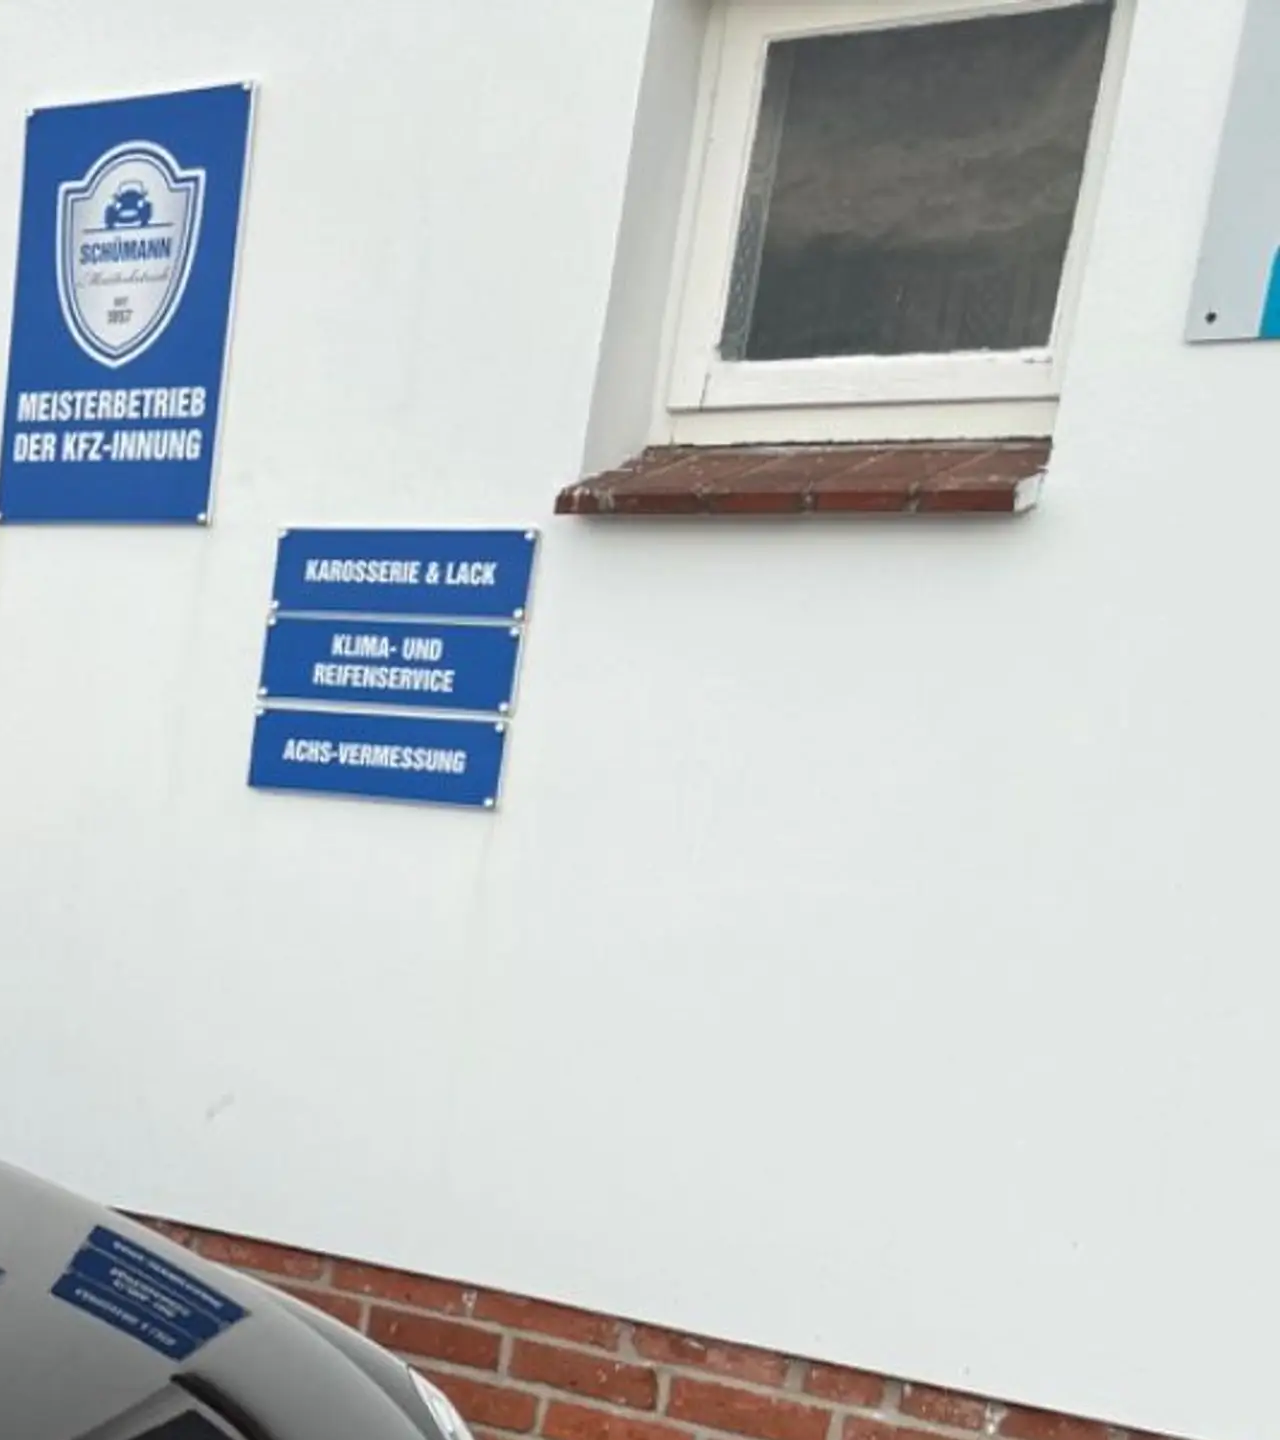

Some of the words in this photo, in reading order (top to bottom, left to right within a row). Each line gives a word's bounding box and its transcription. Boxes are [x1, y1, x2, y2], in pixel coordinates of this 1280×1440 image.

[80, 237, 171, 264] SCHÜMANN
[17, 386, 206, 422] MEISTERBETRIEB
[13, 431, 57, 463] DER
[61, 427, 203, 462] KFZ-INNUNG
[304, 559, 422, 584] KAROSSERIE
[425, 562, 440, 585] &
[444, 561, 498, 585] LACK
[331, 634, 397, 659] KLIMA-
[402, 637, 443, 661] UND
[312, 663, 455, 692] REIFENSERVICE
[282, 738, 467, 773] ACHS-VERMESSUNG
